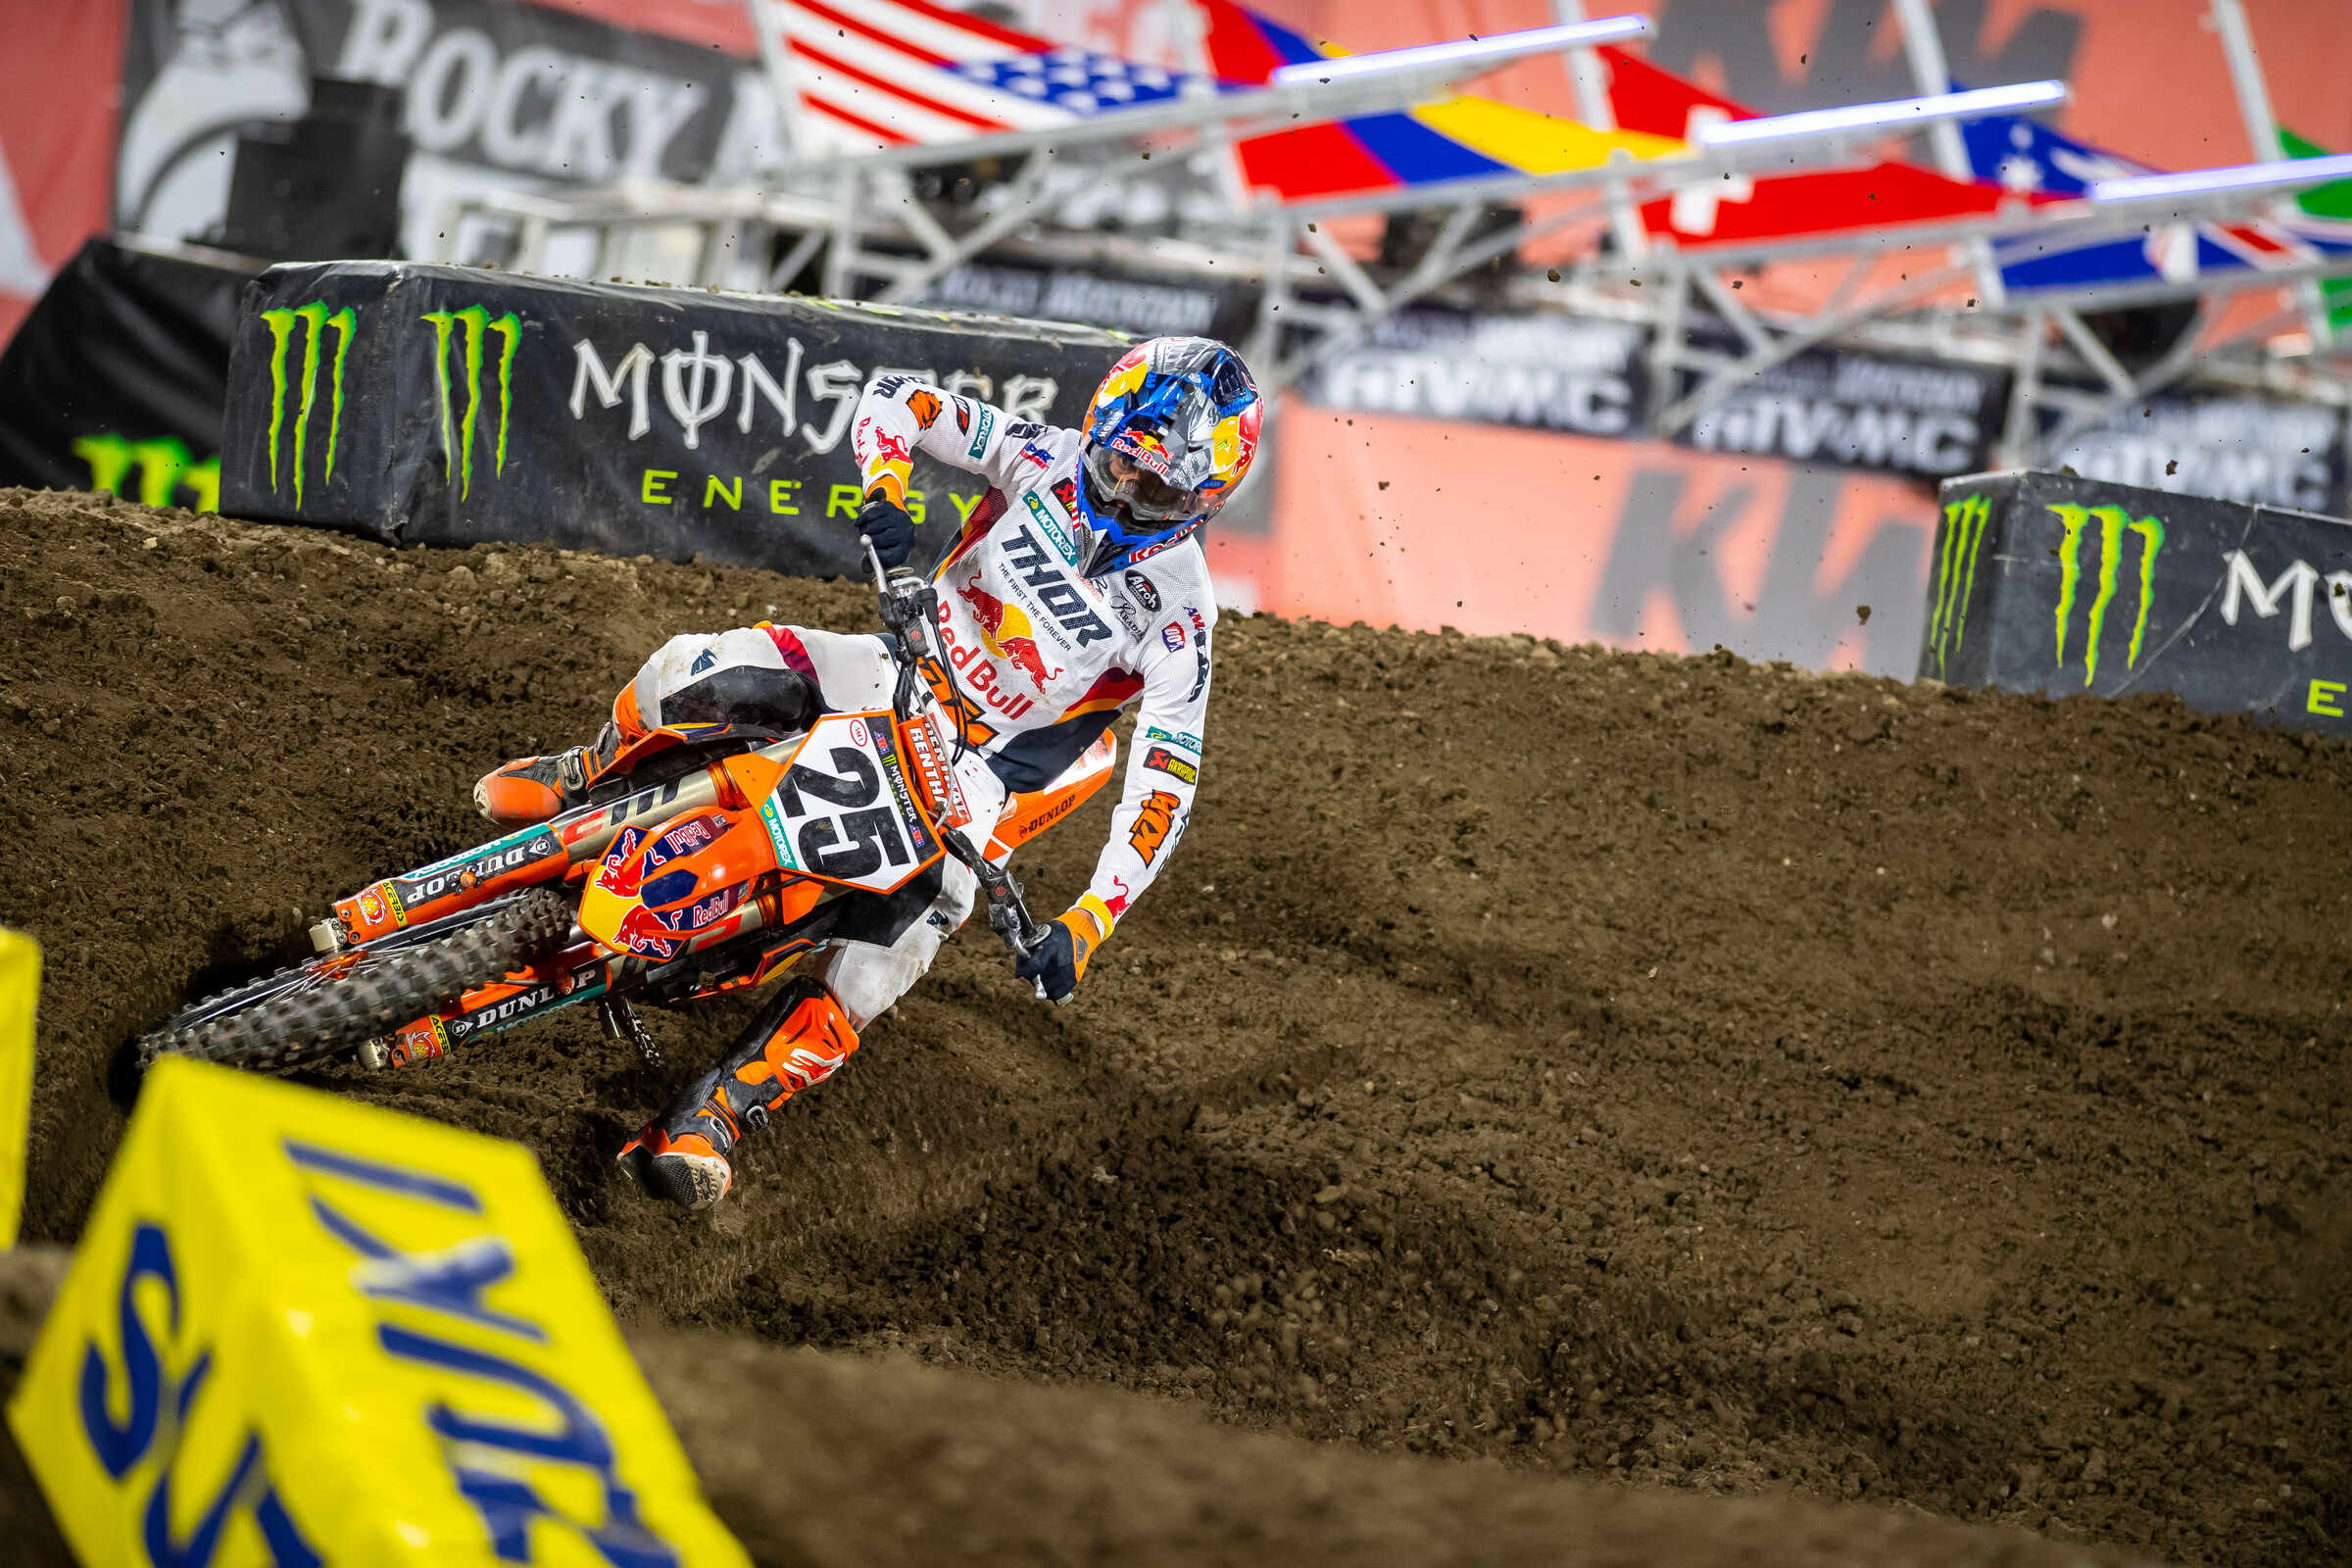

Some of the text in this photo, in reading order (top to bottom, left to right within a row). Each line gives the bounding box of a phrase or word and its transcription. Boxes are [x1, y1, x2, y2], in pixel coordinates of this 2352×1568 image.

[1035, 508, 1076, 562] MOTOREX
[998, 562, 1073, 653] THE FIRST THE FOREVER
[1002, 523, 1113, 649] THOR
[776, 747, 911, 880] 25
[887, 776, 906, 817] ENERGY
[890, 764, 918, 823] MONSTER
[1029, 794, 1076, 833] DUNLOP
[768, 818, 794, 866] MOTOREX
